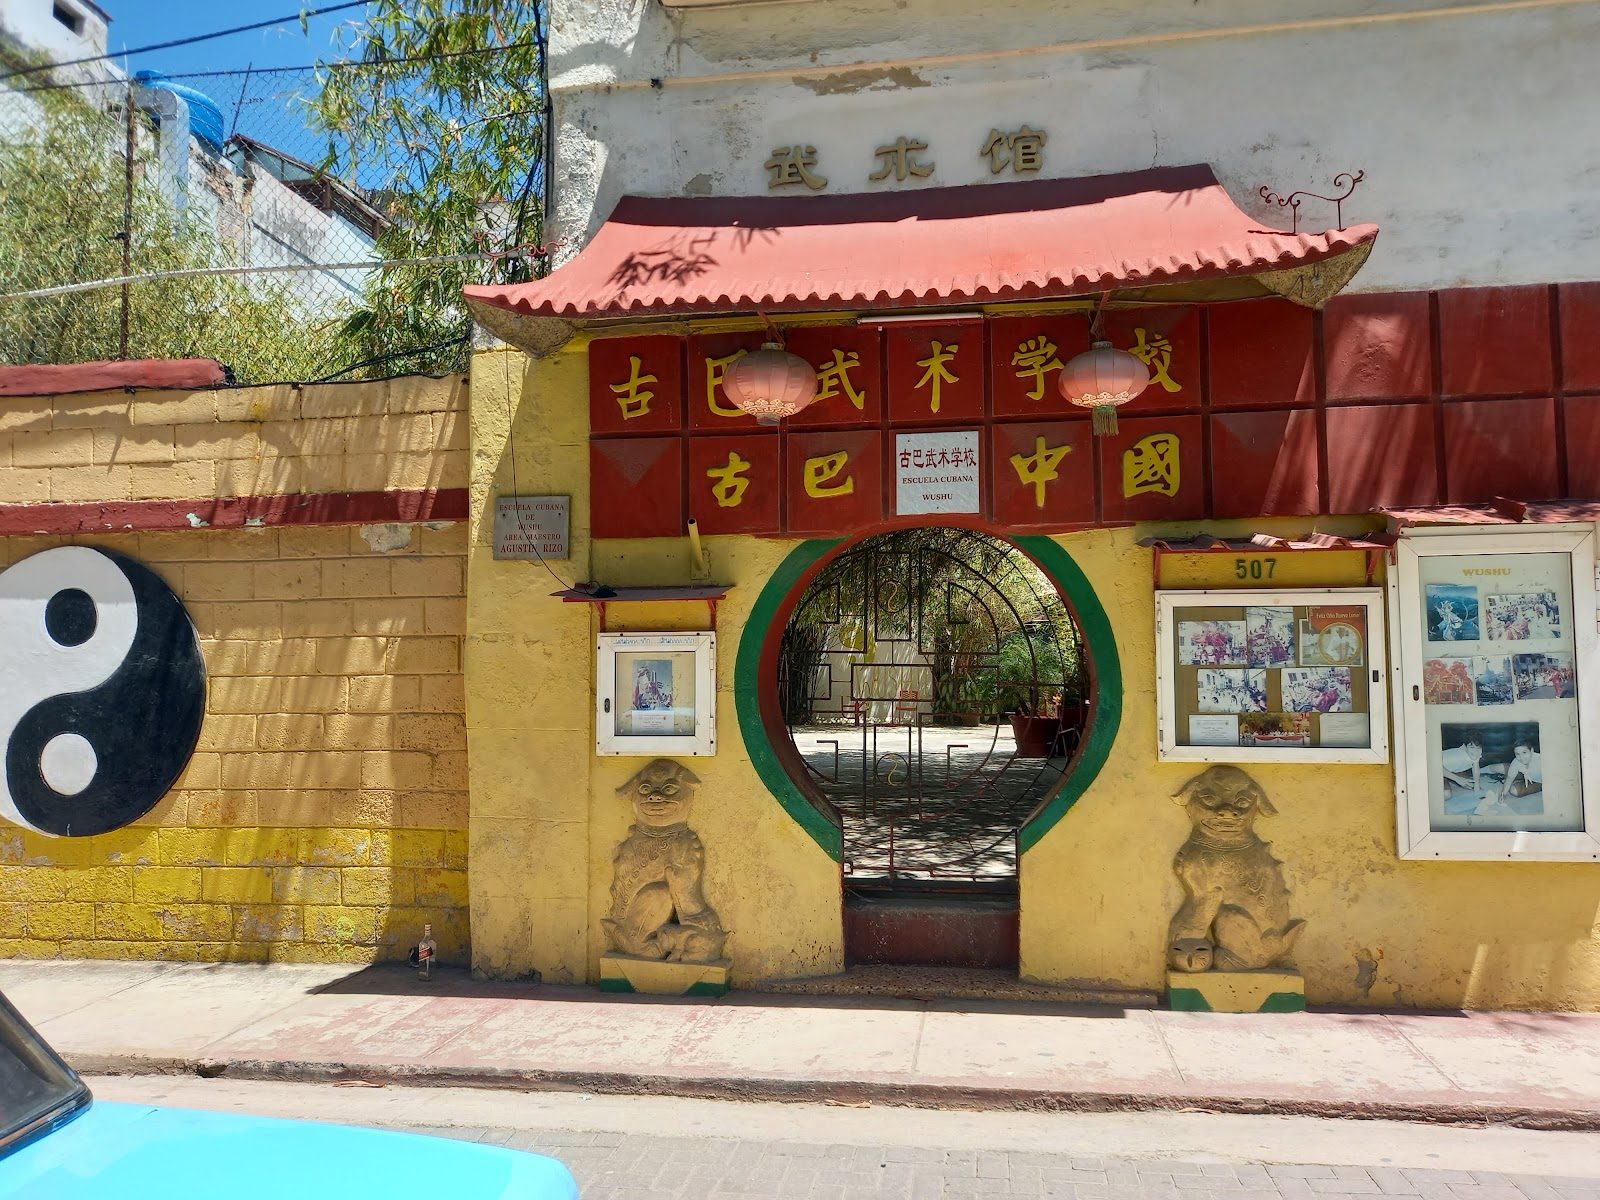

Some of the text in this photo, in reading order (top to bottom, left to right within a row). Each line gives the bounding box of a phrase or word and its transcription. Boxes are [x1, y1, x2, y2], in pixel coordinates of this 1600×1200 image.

[764, 125, 1047, 190] 武术馆
[899, 447, 977, 469] 古巴武术学校
[707, 434, 1180, 508] 古巴 中國
[902, 475, 974, 484] ESCUELA CUBANA
[922, 493, 953, 501] WUSHU
[536, 503, 564, 511] CUBANA
[543, 544, 563, 553] RIZO
[1236, 558, 1277, 579] 507
[1462, 568, 1512, 577] WUSHU
